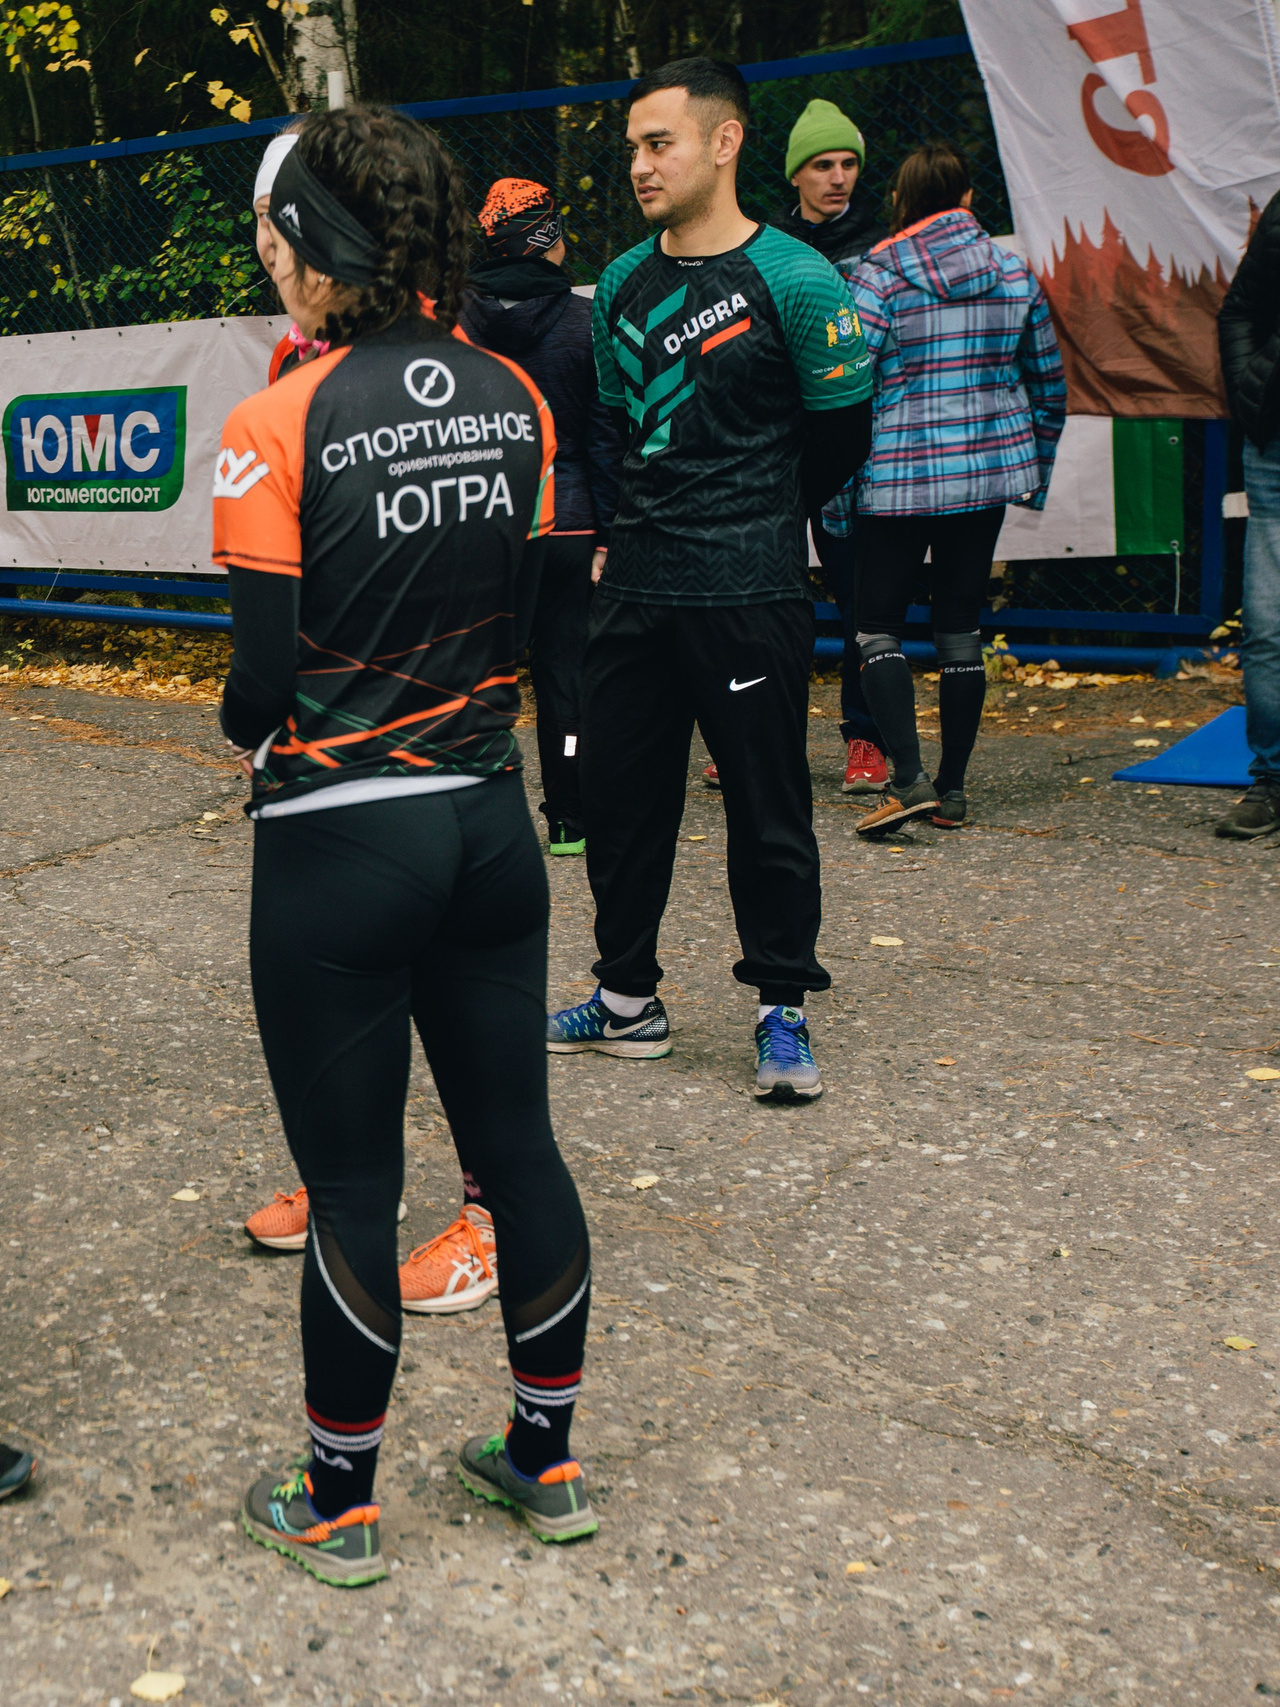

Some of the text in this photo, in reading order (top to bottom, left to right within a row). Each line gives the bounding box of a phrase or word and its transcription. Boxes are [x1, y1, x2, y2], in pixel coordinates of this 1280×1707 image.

[663, 293, 748, 355] O-UGRA
[20, 410, 161, 474] ЮМС
[321, 411, 536, 473] СПОРТИВНОЕ
[387, 447, 504, 478] ориентирование
[376, 472, 515, 539] ЮГРА
